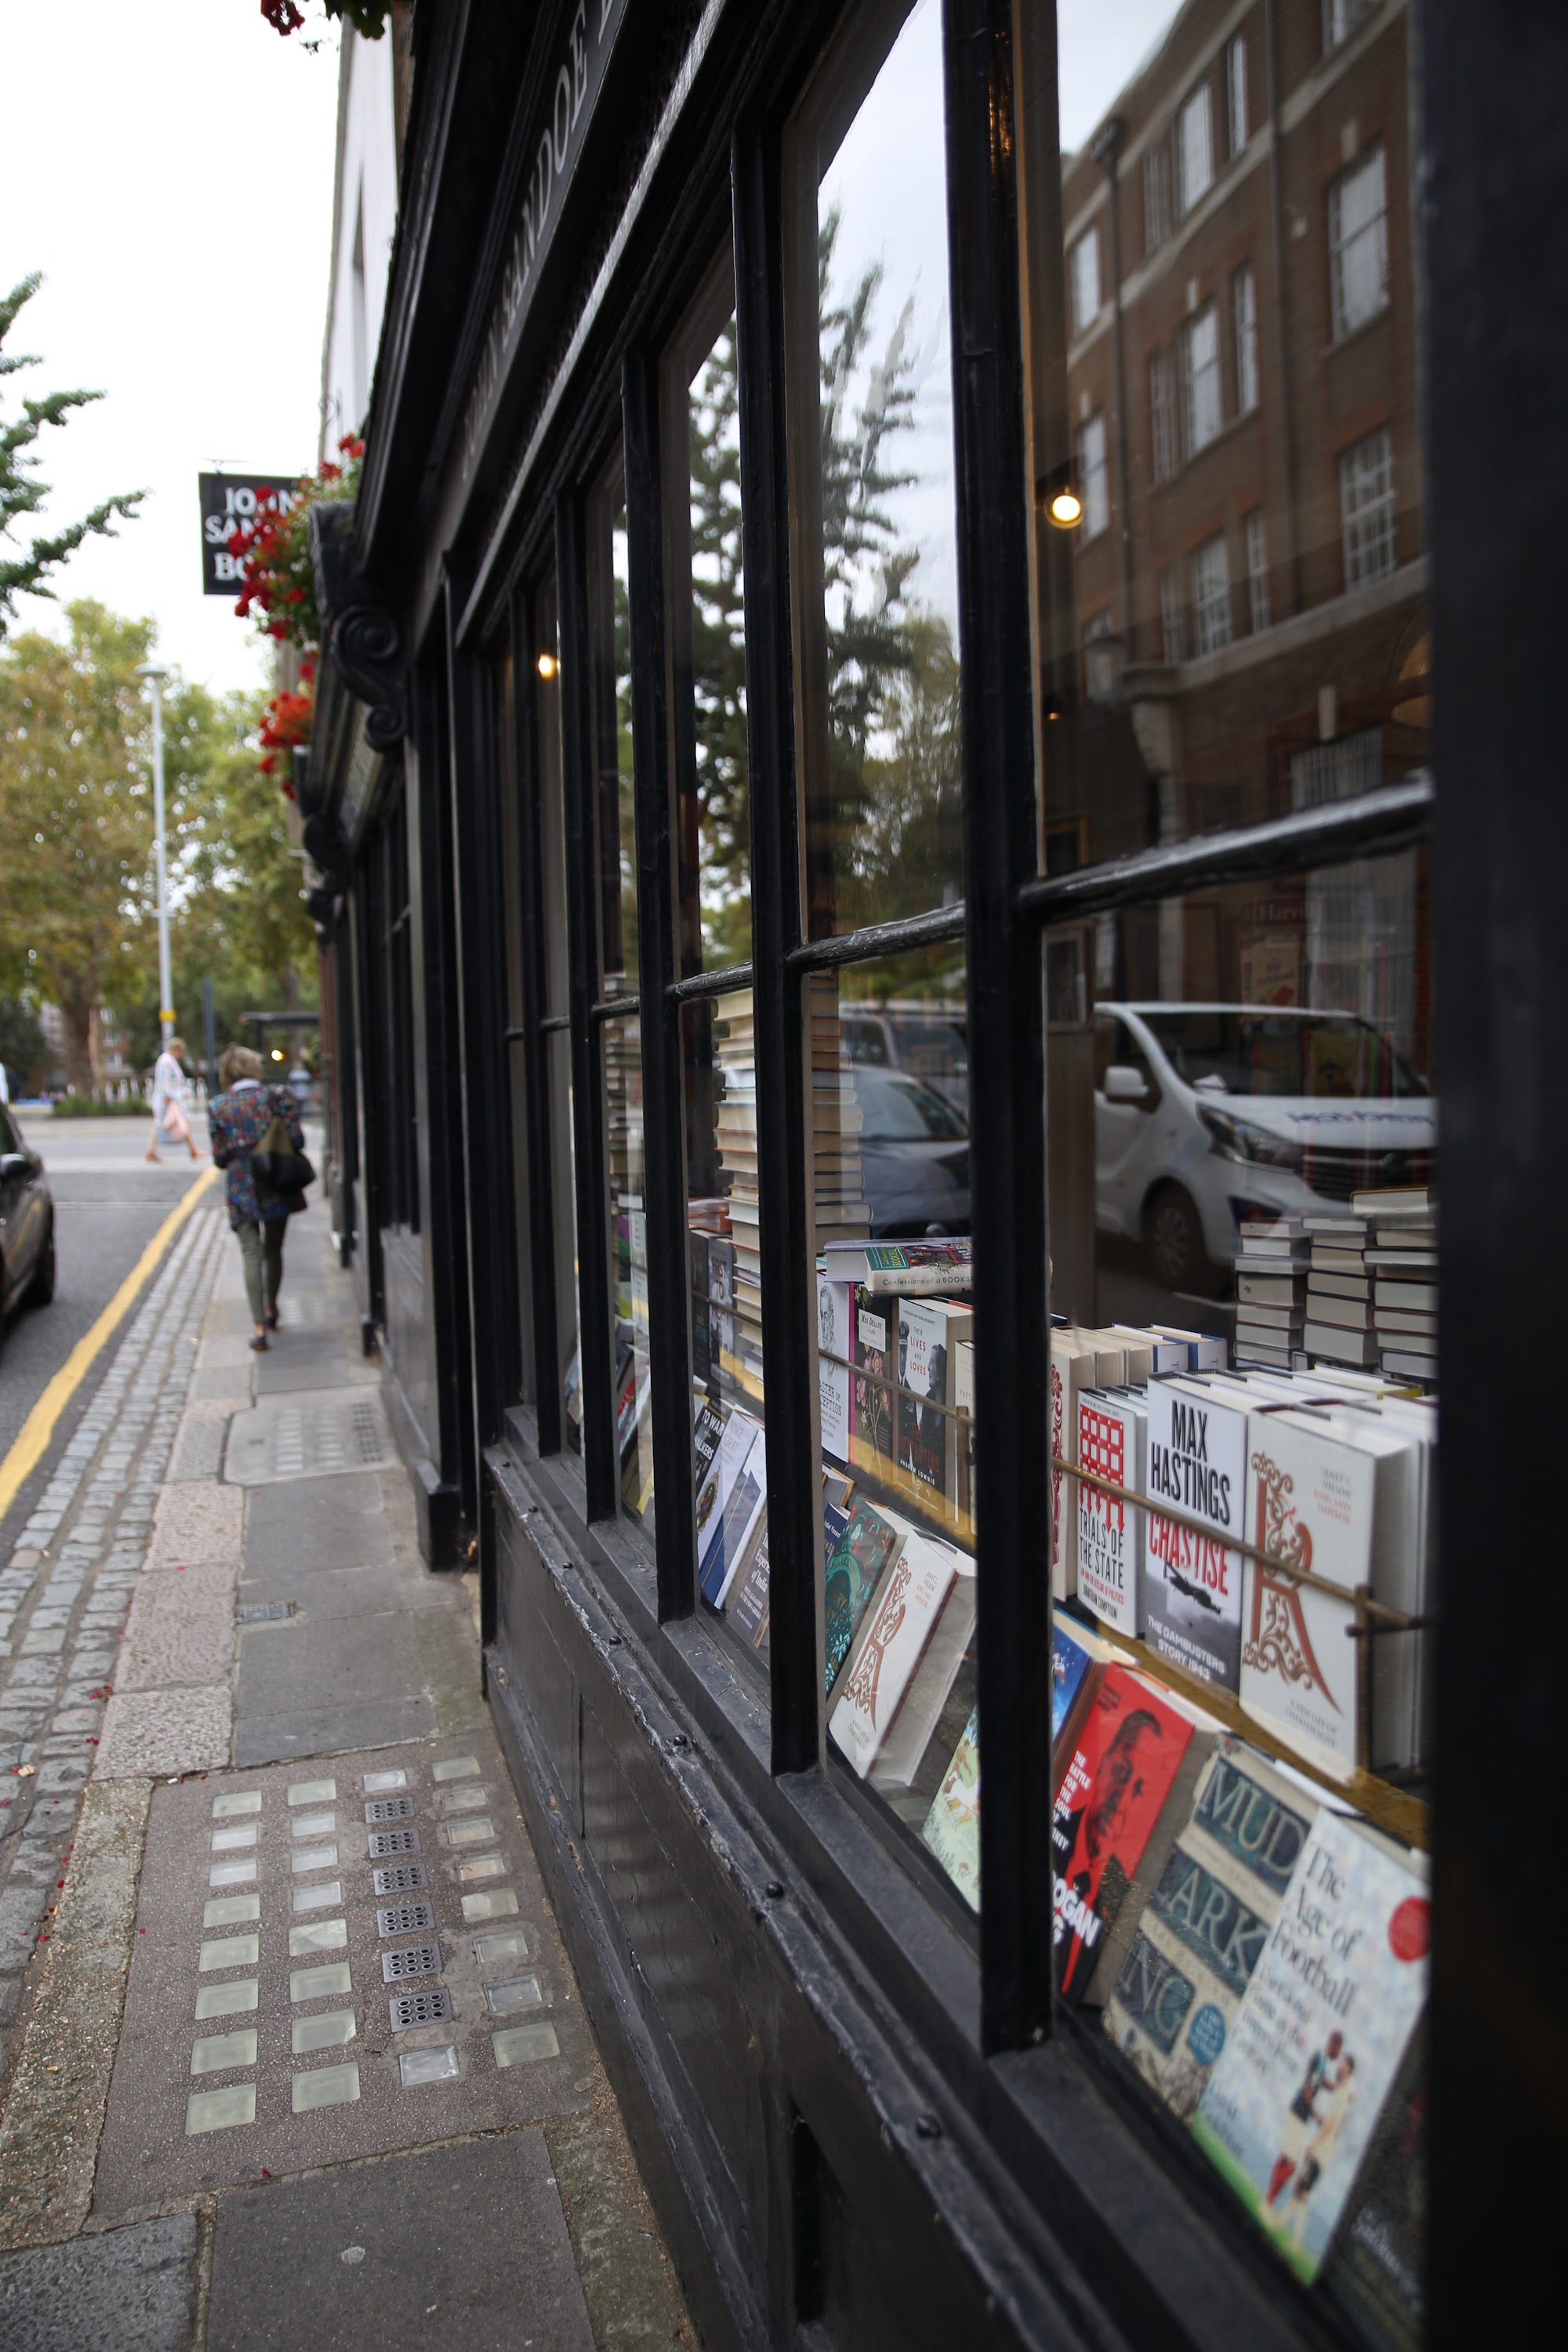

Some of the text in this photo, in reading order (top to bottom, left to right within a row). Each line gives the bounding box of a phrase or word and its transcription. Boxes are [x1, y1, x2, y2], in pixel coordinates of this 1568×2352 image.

[712, 1256, 727, 1279] FIRST
[910, 1336, 926, 1352] LIVES
[910, 1360, 926, 1376] LOVES
[702, 1409, 725, 1437] TO WAR
[1171, 1399, 1207, 1462] MAX
[917, 1470, 935, 1486] LOWNIE
[1150, 1441, 1230, 1526] HASTINGS
[1080, 1507, 1123, 1558] TRIALS OF
[1080, 1536, 1123, 1589] THE STATE
[1149, 1512, 1230, 1596] CHASTISE
[750, 1570, 768, 1593] of India
[1147, 1614, 1226, 1675] THE DAMBUSTERS
[1157, 1638, 1210, 1682] STORY 1943
[1074, 1750, 1087, 1767] THE
[1064, 1773, 1078, 1793] FOR
[1069, 1762, 1092, 1791] BATTLE
[1054, 1797, 1071, 1821] SOUL
[1059, 1785, 1073, 1803] THE
[1199, 1765, 1306, 1877] MUD
[1307, 1846, 1345, 1901] The
[1331, 1928, 1363, 1959] of
[1271, 1918, 1356, 2019] Football
